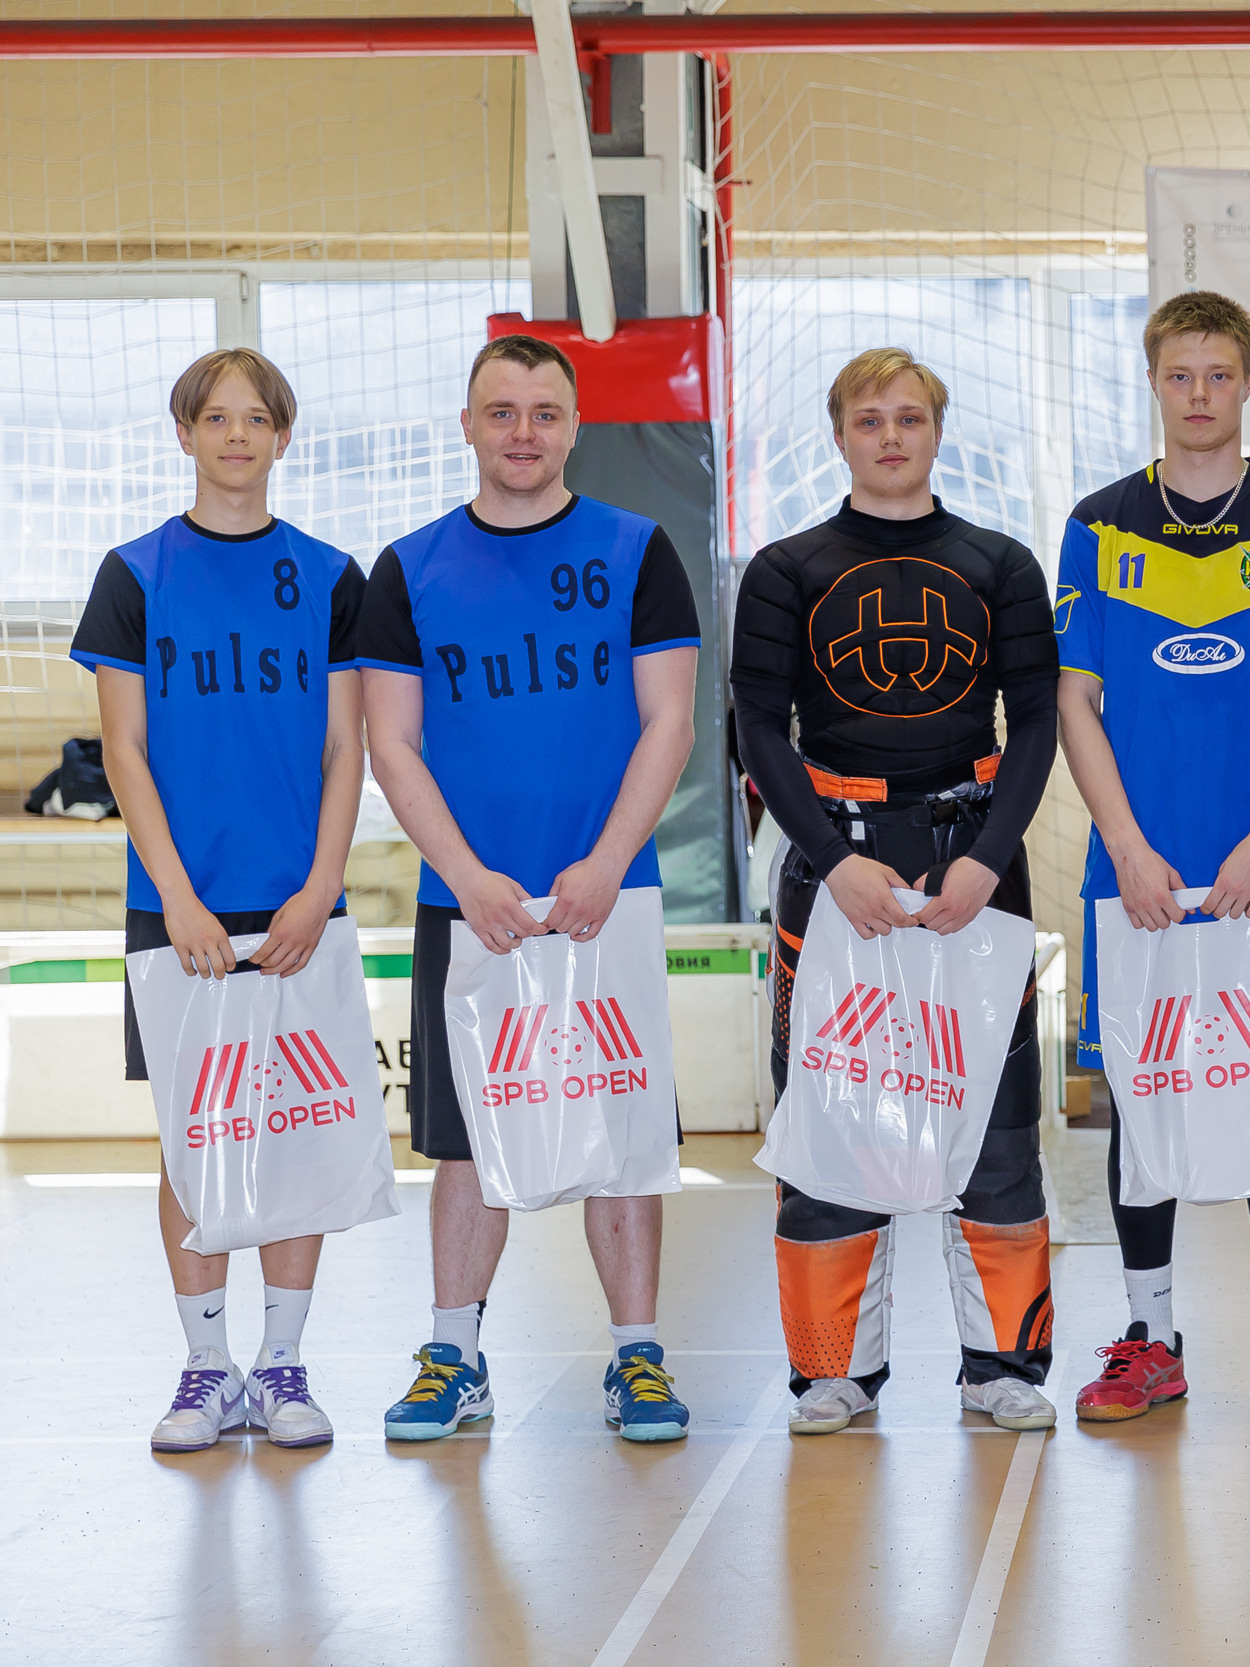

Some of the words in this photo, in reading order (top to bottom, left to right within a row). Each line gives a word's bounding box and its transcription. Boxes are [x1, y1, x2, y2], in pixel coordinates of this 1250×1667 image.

[1162, 524, 1239, 535] GIVOVA
[273, 558, 300, 611] 8
[551, 558, 611, 612] 96
[1118, 552, 1146, 589] 11
[157, 632, 309, 698] Pulse
[436, 632, 611, 703] Pulse
[482, 1080, 549, 1108] SPB
[563, 1067, 647, 1100] OPEN
[802, 1046, 868, 1084] SPB
[881, 1069, 965, 1111] OPEN
[1133, 1070, 1193, 1097] SPB
[187, 1117, 256, 1149] SPB
[267, 1096, 356, 1134] OPEN
